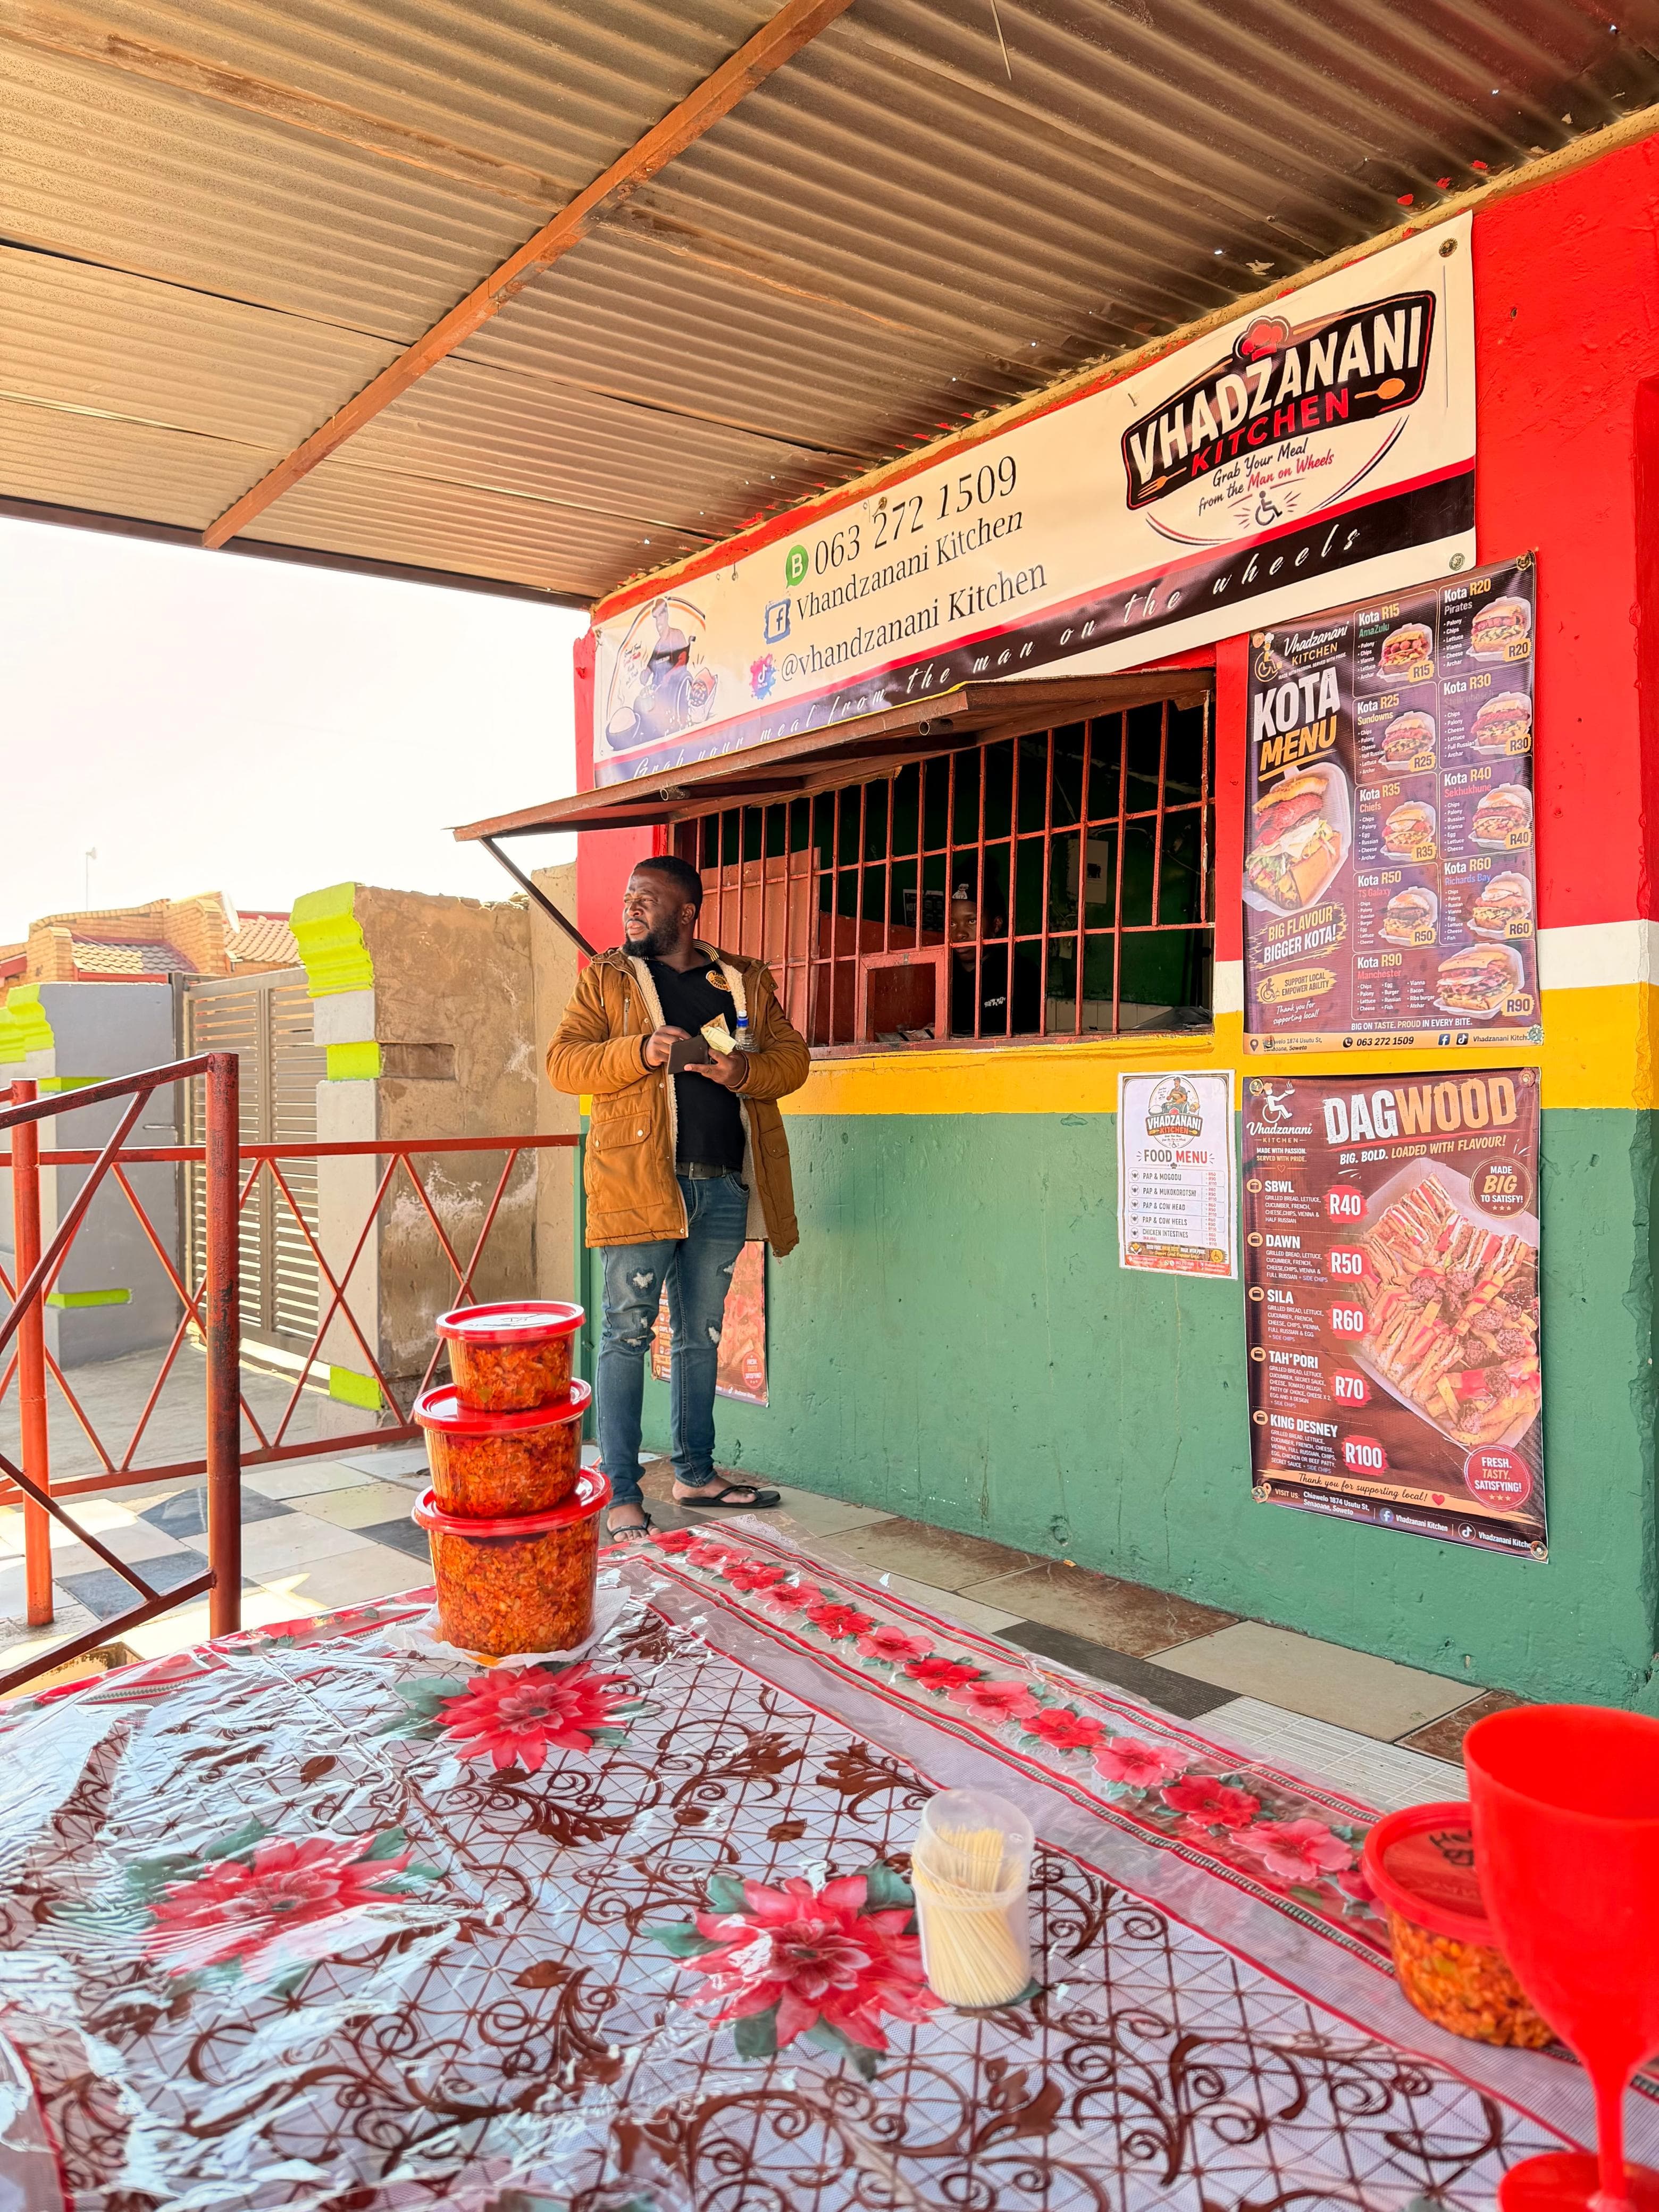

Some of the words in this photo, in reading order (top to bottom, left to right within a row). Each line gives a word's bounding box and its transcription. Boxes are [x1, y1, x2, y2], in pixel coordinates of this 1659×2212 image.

[1129, 306, 1422, 485] VHADZANANI
[1191, 388, 1350, 477] KITCHEN
[1213, 462, 1241, 487] Grab
[1244, 455, 1273, 477] Your
[1277, 437, 1309, 462] Meal
[1199, 494, 1224, 516] from
[1227, 482, 1244, 498] the
[1247, 472, 1275, 491] Man
[1278, 468, 1293, 479] on
[1296, 449, 1335, 474] Wheels
[815, 525, 860, 575] 063
[874, 495, 924, 550] 272
[936, 456, 1017, 521] 1509
[797, 545, 929, 621] Vhandzanani
[936, 511, 1023, 566] Kitchen
[1444, 587, 1467, 603] Kota
[1470, 578, 1491, 596] R20
[1359, 611, 1380, 626] Kota
[1381, 603, 1400, 621] R15
[1444, 601, 1472, 615] Pirates
[781, 598, 940, 682] @vhandzanani
[948, 564, 1048, 623] Kitchen
[1359, 623, 1389, 638] AmaZulu
[760, 705, 818, 742] meal
[827, 688, 886, 725] from
[906, 664, 951, 694] the
[973, 641, 1035, 674] man
[1060, 619, 1096, 646] on
[1123, 587, 1182, 625] the
[1213, 524, 1361, 595] wheels
[1284, 621, 1350, 657] Vhadzanani
[1292, 642, 1337, 666] KITCHEN
[1509, 642, 1528, 658] R20
[1413, 664, 1430, 678] R15
[1444, 681, 1467, 695] Kota
[1470, 673, 1491, 690] R30
[1253, 666, 1340, 742] KOTA
[1358, 701, 1378, 714] Kota
[1380, 693, 1400, 709] R25
[1358, 711, 1394, 726] Sundowns
[1260, 715, 1337, 771] MENU
[1510, 737, 1528, 751] R30
[1414, 755, 1432, 768] R25
[1444, 773, 1468, 786] Kota
[1470, 766, 1492, 782] R40
[1360, 789, 1380, 802] Kota
[1382, 782, 1401, 798] R35
[1444, 784, 1492, 798] Sekhukhune
[1360, 801, 1381, 813] Chiefs
[1510, 832, 1529, 845] R40
[1416, 845, 1433, 859] R35
[1444, 862, 1467, 875] Kota
[1469, 857, 1492, 872] R60
[1358, 875, 1379, 887] Kota
[1381, 870, 1402, 884] R50
[1445, 875, 1475, 886] Richards
[1477, 873, 1491, 882] Bay
[1368, 887, 1391, 897] Galaxy
[1268, 924, 1285, 943] BIG
[1287, 905, 1333, 935] FLAVOUR
[1510, 923, 1529, 935] R60
[1263, 936, 1302, 964] BIGGER
[1304, 924, 1336, 950] KOTA!
[1414, 930, 1432, 942] R50
[1358, 957, 1379, 969] Kota
[1381, 953, 1402, 967] R90
[1285, 975, 1308, 987] SUPPORT
[1309, 972, 1326, 982] LOCAL
[1358, 969, 1402, 980] Manchester
[1281, 984, 1308, 996] EMPOWER
[1309, 980, 1329, 992] ABILITY
[1506, 998, 1530, 1013] R90
[1374, 1021, 1396, 1029] TASTE.
[1455, 1018, 1473, 1026] BITE.
[1375, 1037, 1390, 1045] 272
[1393, 1036, 1414, 1045] 1509
[1322, 1077, 1517, 1144] DAGWOOD
[1147, 1115, 1201, 1130] VHADZANANI
[1246, 1121, 1313, 1136] Vhadzanani
[1144, 1149, 1172, 1162] FOOD
[1176, 1150, 1208, 1164] MENU
[1340, 1154, 1359, 1165] BIG.
[1361, 1149, 1388, 1163] BOLD.
[1391, 1145, 1427, 1159] LOADED
[1429, 1141, 1454, 1154] WITH
[1457, 1135, 1506, 1151] FLAVOUR!
[1264, 1180, 1295, 1193] SBWL
[1483, 1175, 1518, 1193] BIG
[1329, 1194, 1361, 1216] R40
[1492, 1195, 1523, 1203] SATISFY!
[1266, 1234, 1301, 1249] DAWN
[1331, 1252, 1362, 1275] R50
[1267, 1289, 1294, 1304] SILA
[1333, 1308, 1363, 1332] R60
[1269, 1350, 1319, 1369] TAH'PORI
[1335, 1376, 1364, 1400] R70
[1270, 1414, 1295, 1430] KING
[1296, 1419, 1338, 1438] DESNEY
[1345, 1443, 1382, 1469] R100
[1481, 1456, 1512, 1469] FRESH.
[1482, 1469, 1510, 1480] TASTY.
[1275, 1488, 1289, 1497] VISIT
[1298, 1473, 1322, 1485] Thank
[1325, 1480, 1339, 1489] you
[1341, 1481, 1353, 1492] for
[1356, 1484, 1400, 1499] supporting
[1402, 1489, 1428, 1502] local!
[1474, 1480, 1522, 1493] SATISFYING!
[1303, 1491, 1328, 1502] Chiawelo
[1330, 1496, 1343, 1505] 1874
[1344, 1500, 1361, 1509] Usutu
[1396, 1514, 1426, 1527] Vhadzanani
[1427, 1519, 1448, 1532] Kitchen
